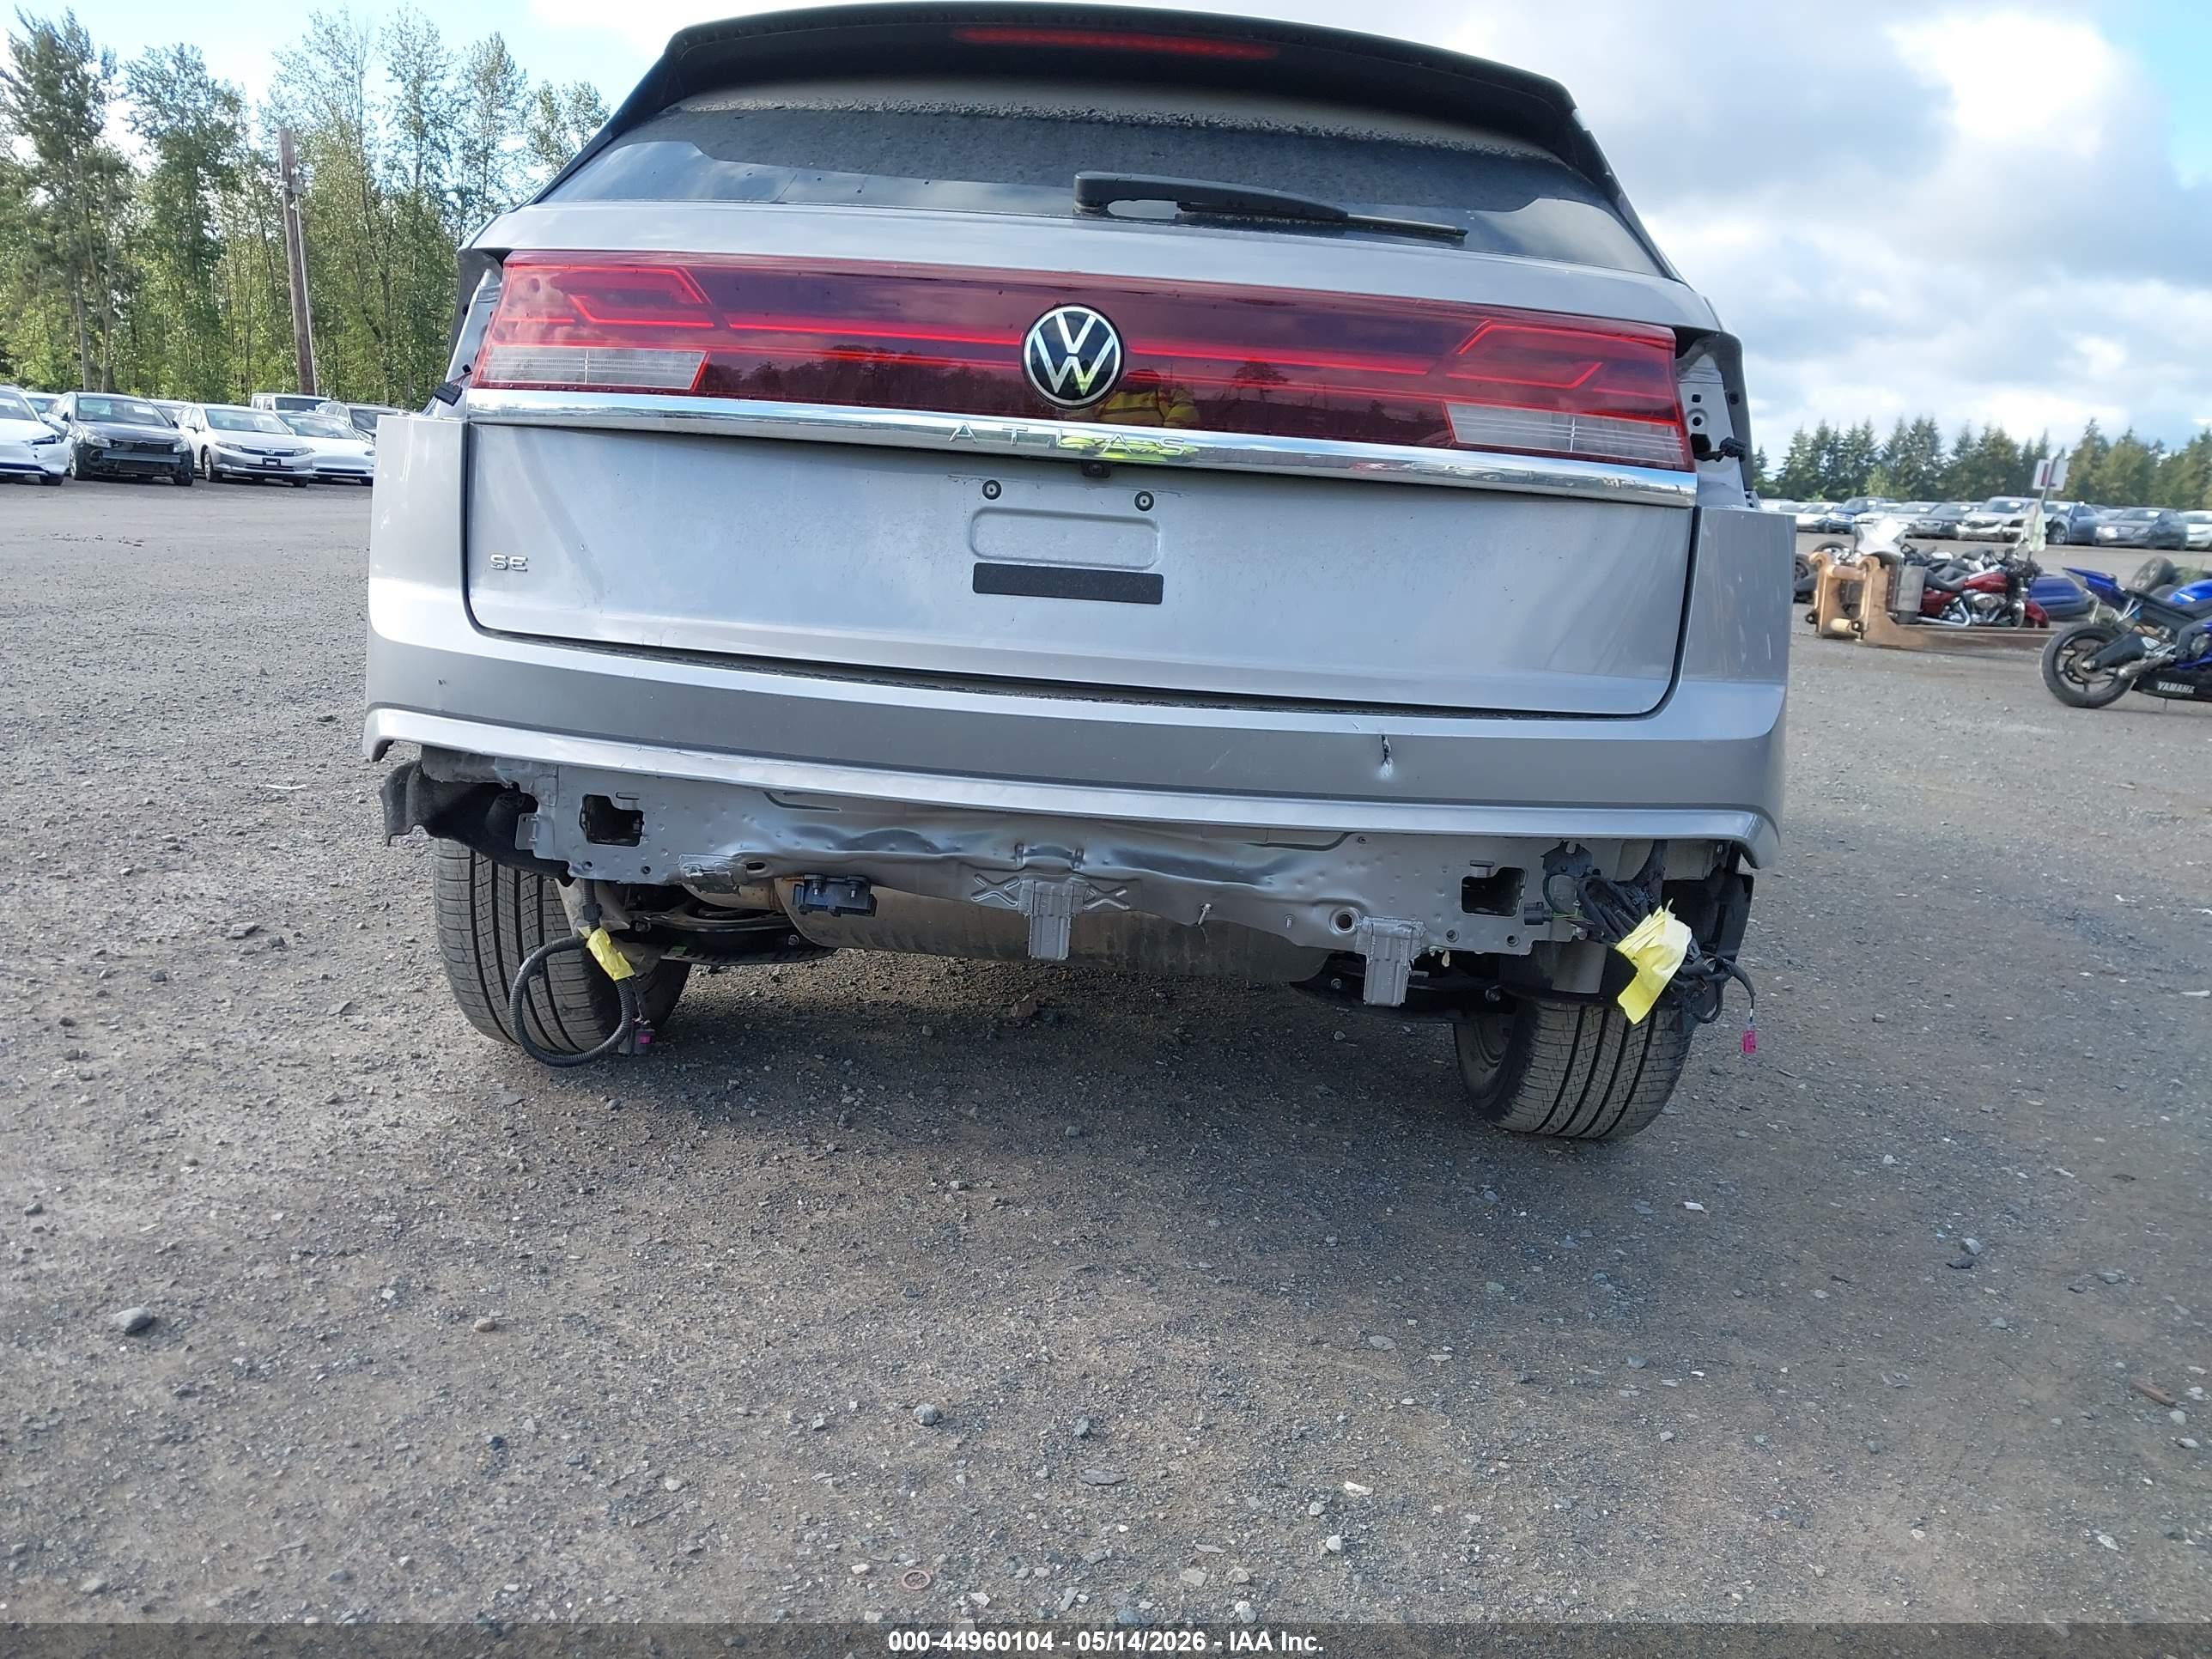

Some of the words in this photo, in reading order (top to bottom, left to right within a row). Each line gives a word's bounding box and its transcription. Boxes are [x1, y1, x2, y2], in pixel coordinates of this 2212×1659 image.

[1033, 311, 1115, 396] VW
[948, 421, 1185, 457] ATLAS
[490, 554, 528, 572] SE
[2157, 681, 2196, 694] YAMAHA
